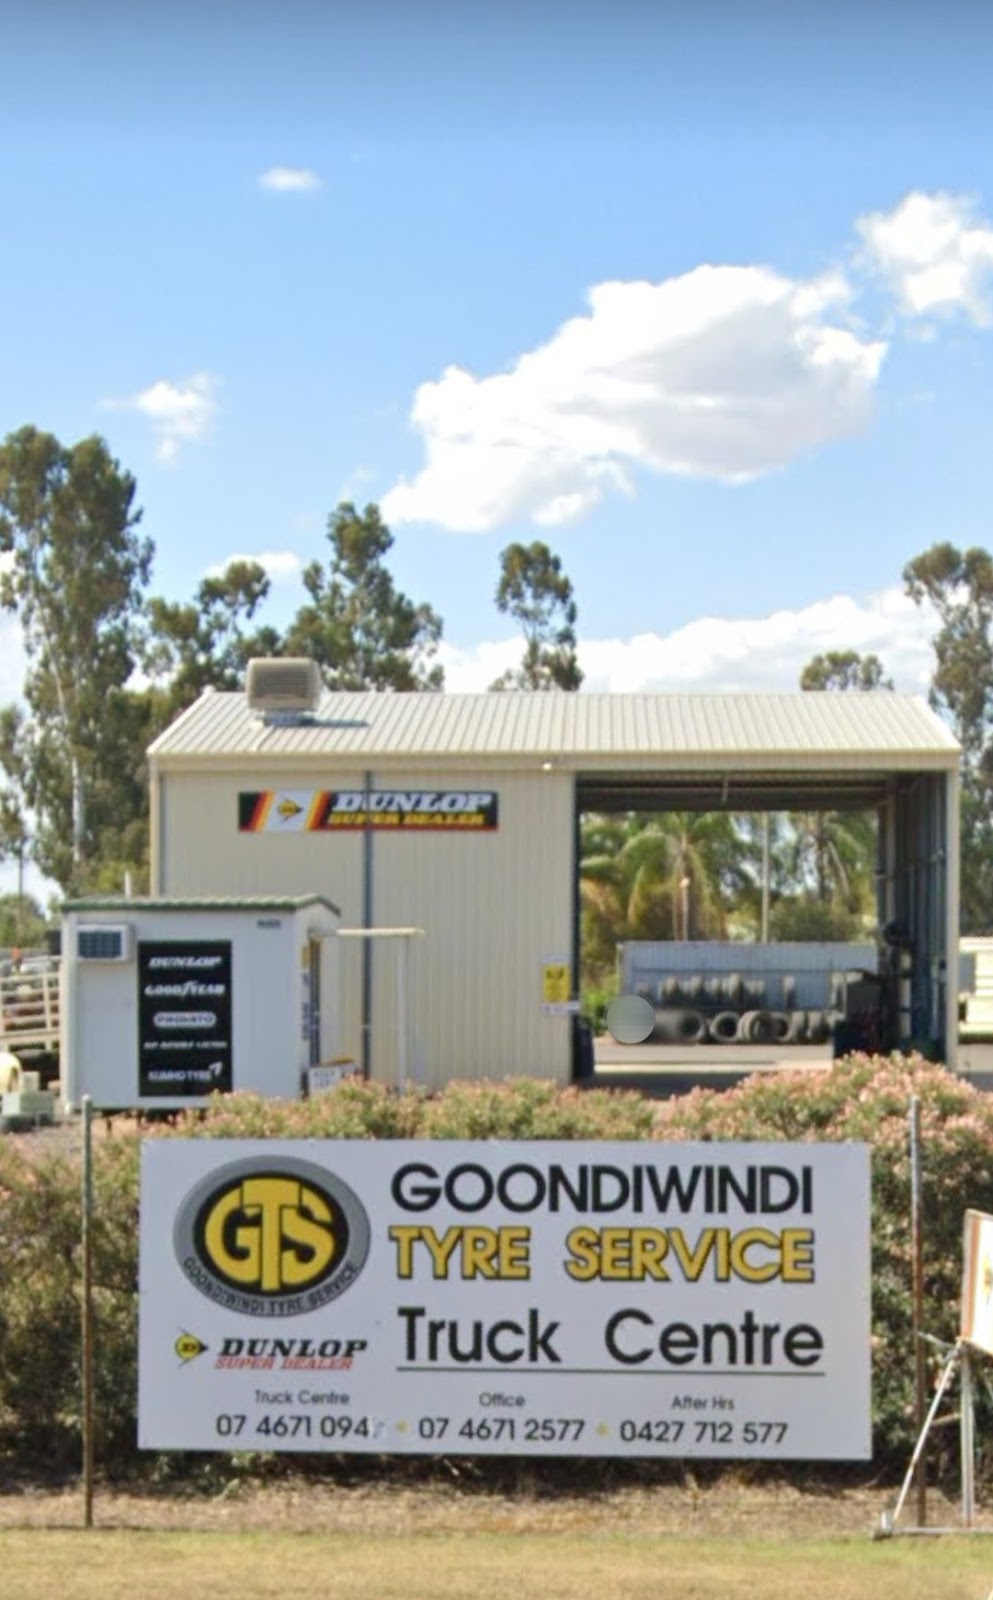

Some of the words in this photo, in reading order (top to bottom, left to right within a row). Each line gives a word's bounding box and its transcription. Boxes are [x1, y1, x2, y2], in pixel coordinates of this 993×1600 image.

[332, 793, 492, 812] DUNLOP
[403, 814, 485, 824] DEALER
[148, 956, 222, 968] DUNLOP
[391, 1163, 813, 1214] GOONDIWINDI
[204, 1179, 336, 1291] GTS
[389, 1225, 531, 1281] TYRE
[564, 1227, 816, 1284] SERVICE
[183, 1256, 265, 1313] GOONDIWINDI
[270, 1301, 304, 1316] TYRE
[307, 1263, 357, 1305] SERVICE
[397, 1307, 561, 1364] Truck
[605, 1308, 824, 1366] Centre
[218, 1338, 368, 1358] DUNLOP
[215, 1356, 274, 1370] SUPER
[281, 1357, 353, 1371] DEALER
[255, 1389, 293, 1405] Truck
[298, 1389, 350, 1405] Centre
[478, 1392, 526, 1408] Office
[671, 1396, 707, 1411] After
[712, 1396, 735, 1411] Hrs
[216, 1415, 247, 1437] 07
[256, 1415, 312, 1438] 4671
[418, 1417, 450, 1440] 07
[458, 1418, 516, 1441] 4671
[523, 1419, 585, 1442] 2577
[619, 1420, 685, 1443] 0427
[694, 1421, 733, 1444] 712
[742, 1422, 789, 1445] 577
